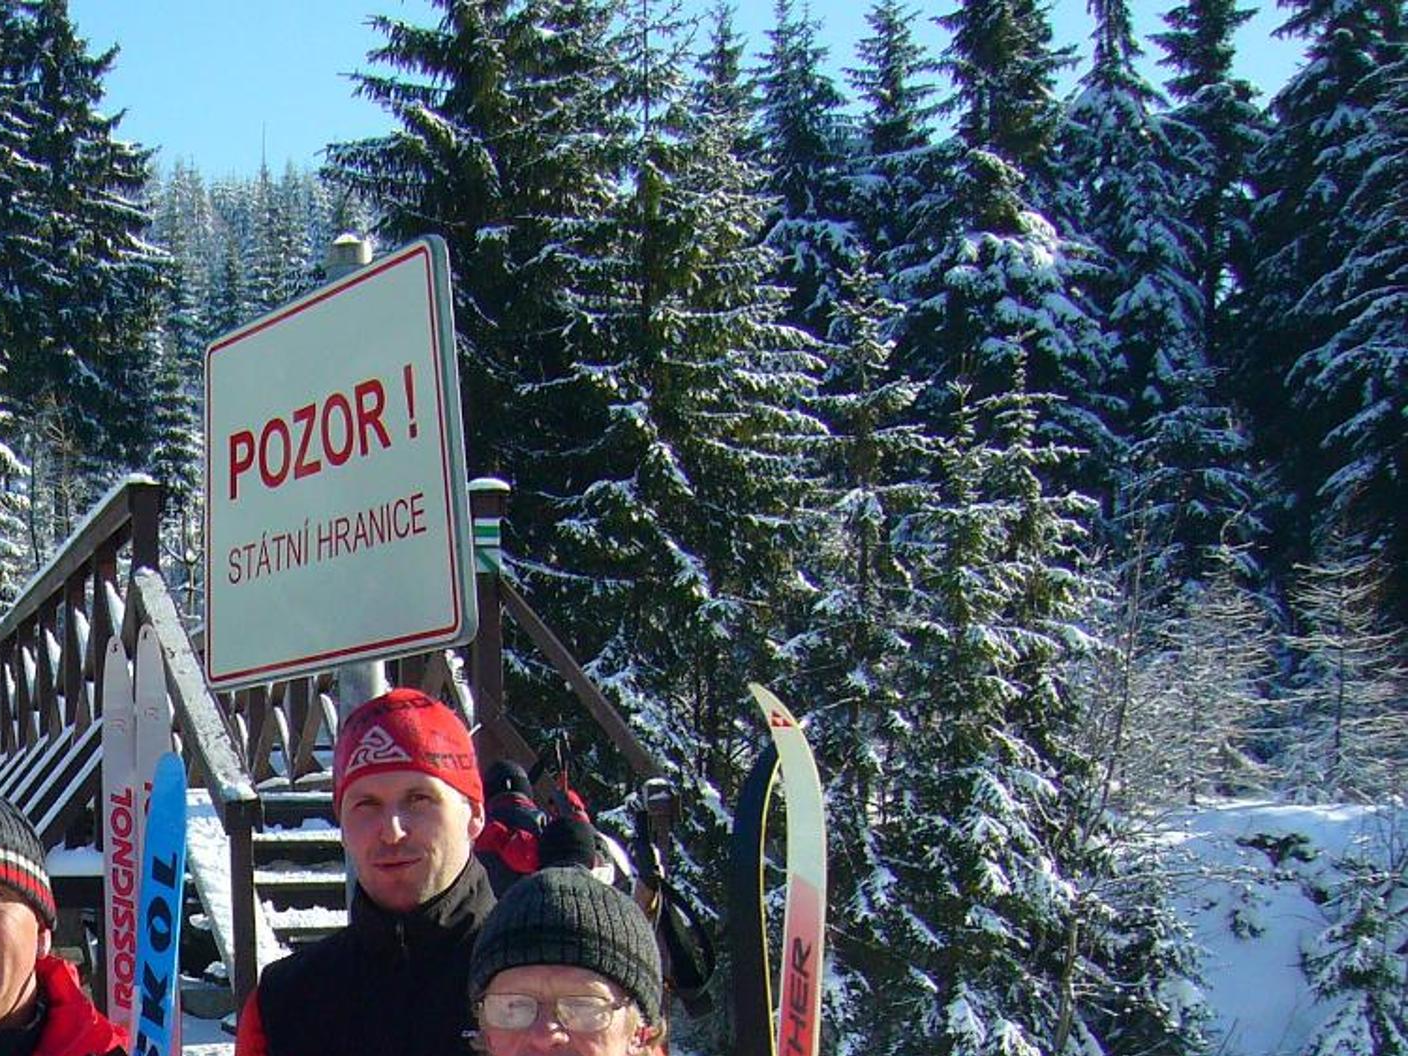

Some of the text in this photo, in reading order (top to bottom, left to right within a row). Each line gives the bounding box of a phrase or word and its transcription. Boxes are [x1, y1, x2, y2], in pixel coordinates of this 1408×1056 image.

[227, 492, 428, 585] STÁTNÍ HRANICE
[109, 787, 137, 1010] ROSSIGNOL
